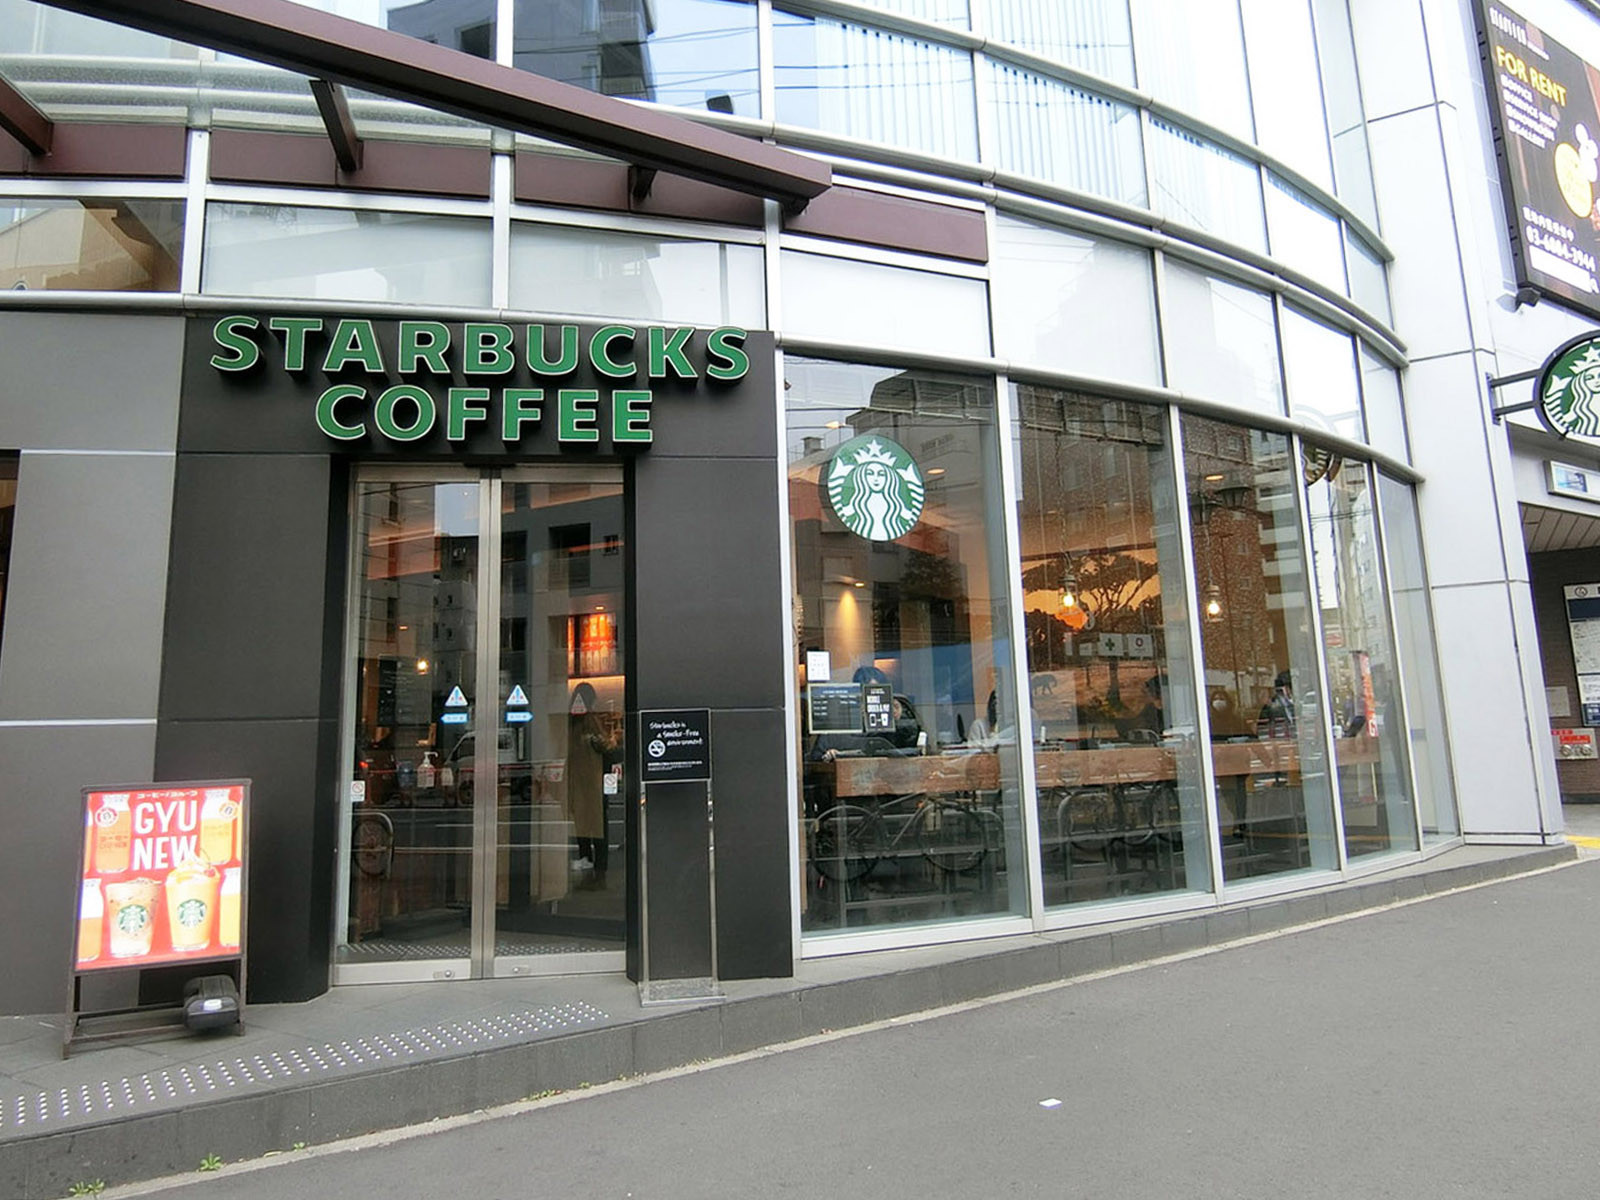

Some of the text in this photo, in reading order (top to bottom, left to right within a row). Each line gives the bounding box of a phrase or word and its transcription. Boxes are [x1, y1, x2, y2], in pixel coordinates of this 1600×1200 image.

[1495, 46, 1528, 83] FOR
[1529, 67, 1567, 107] RENT
[210, 315, 750, 382] STARBUCKS
[315, 384, 653, 444] COFFEE
[134, 800, 197, 834] GYU
[132, 835, 197, 870] NEW
